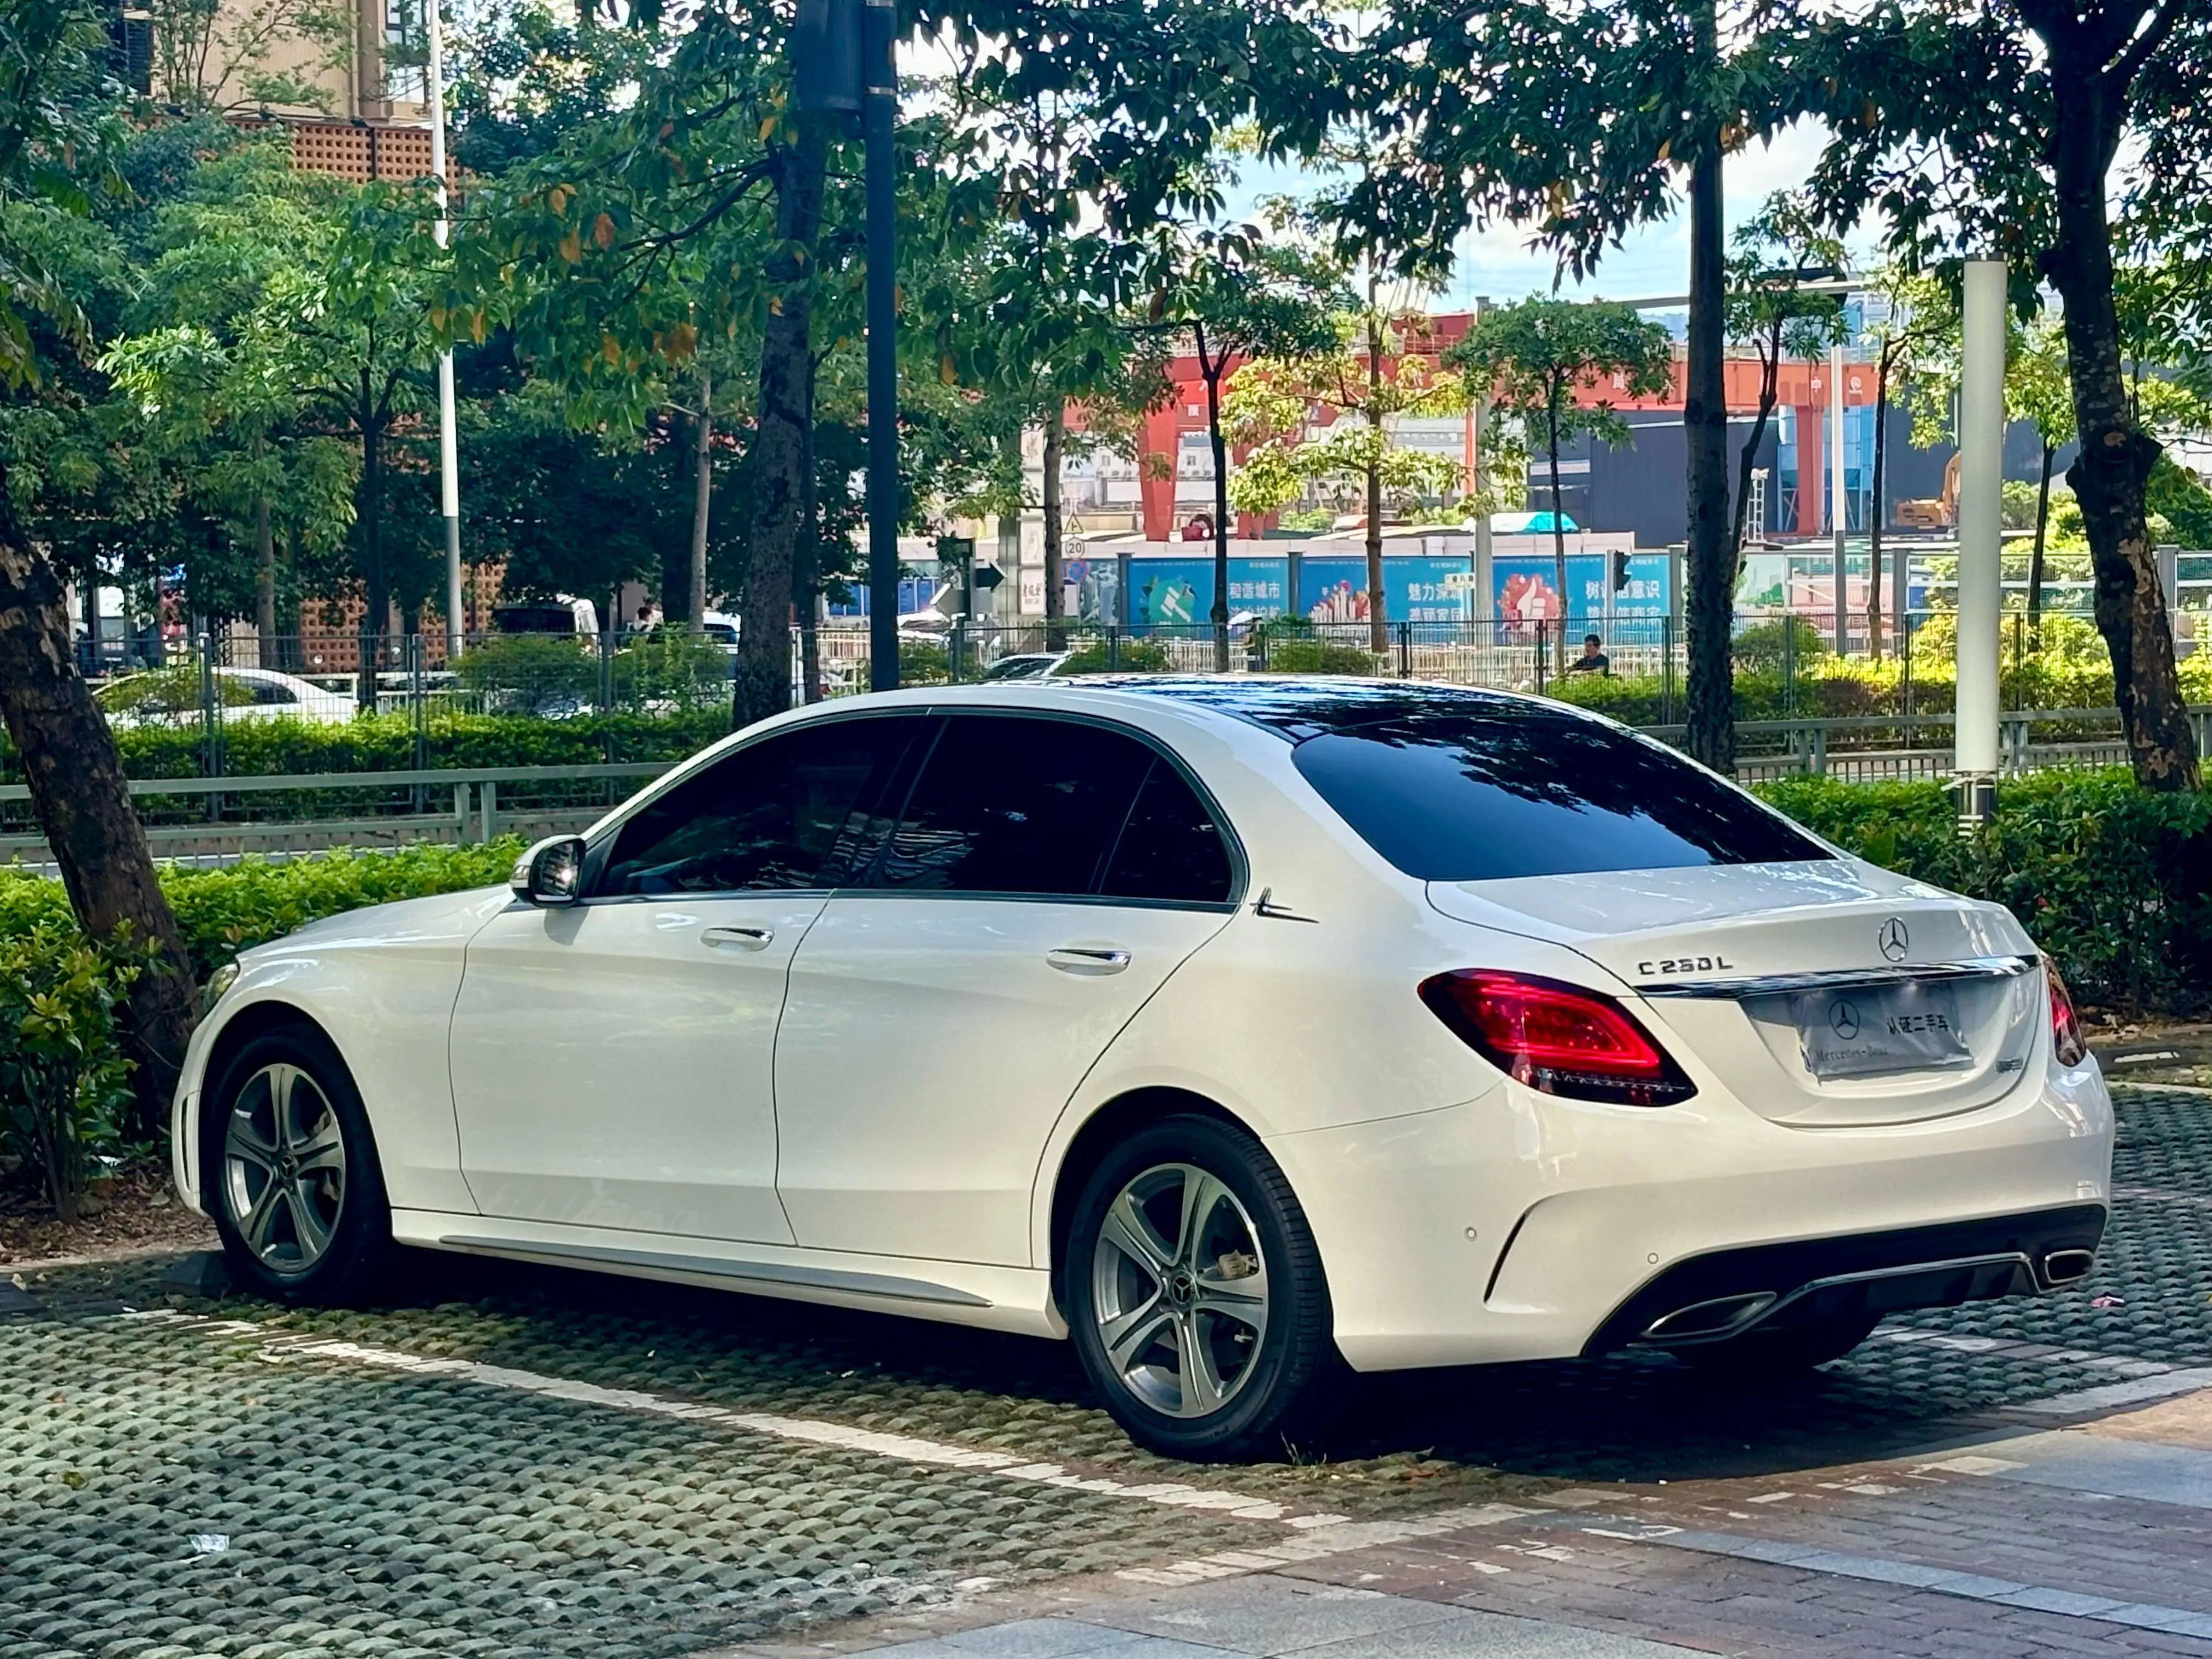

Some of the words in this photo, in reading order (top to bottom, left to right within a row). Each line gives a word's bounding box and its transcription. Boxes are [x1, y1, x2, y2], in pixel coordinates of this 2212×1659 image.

[1068, 542, 1082, 554] 20
[1886, 1013, 1949, 1036] 认证二手车
